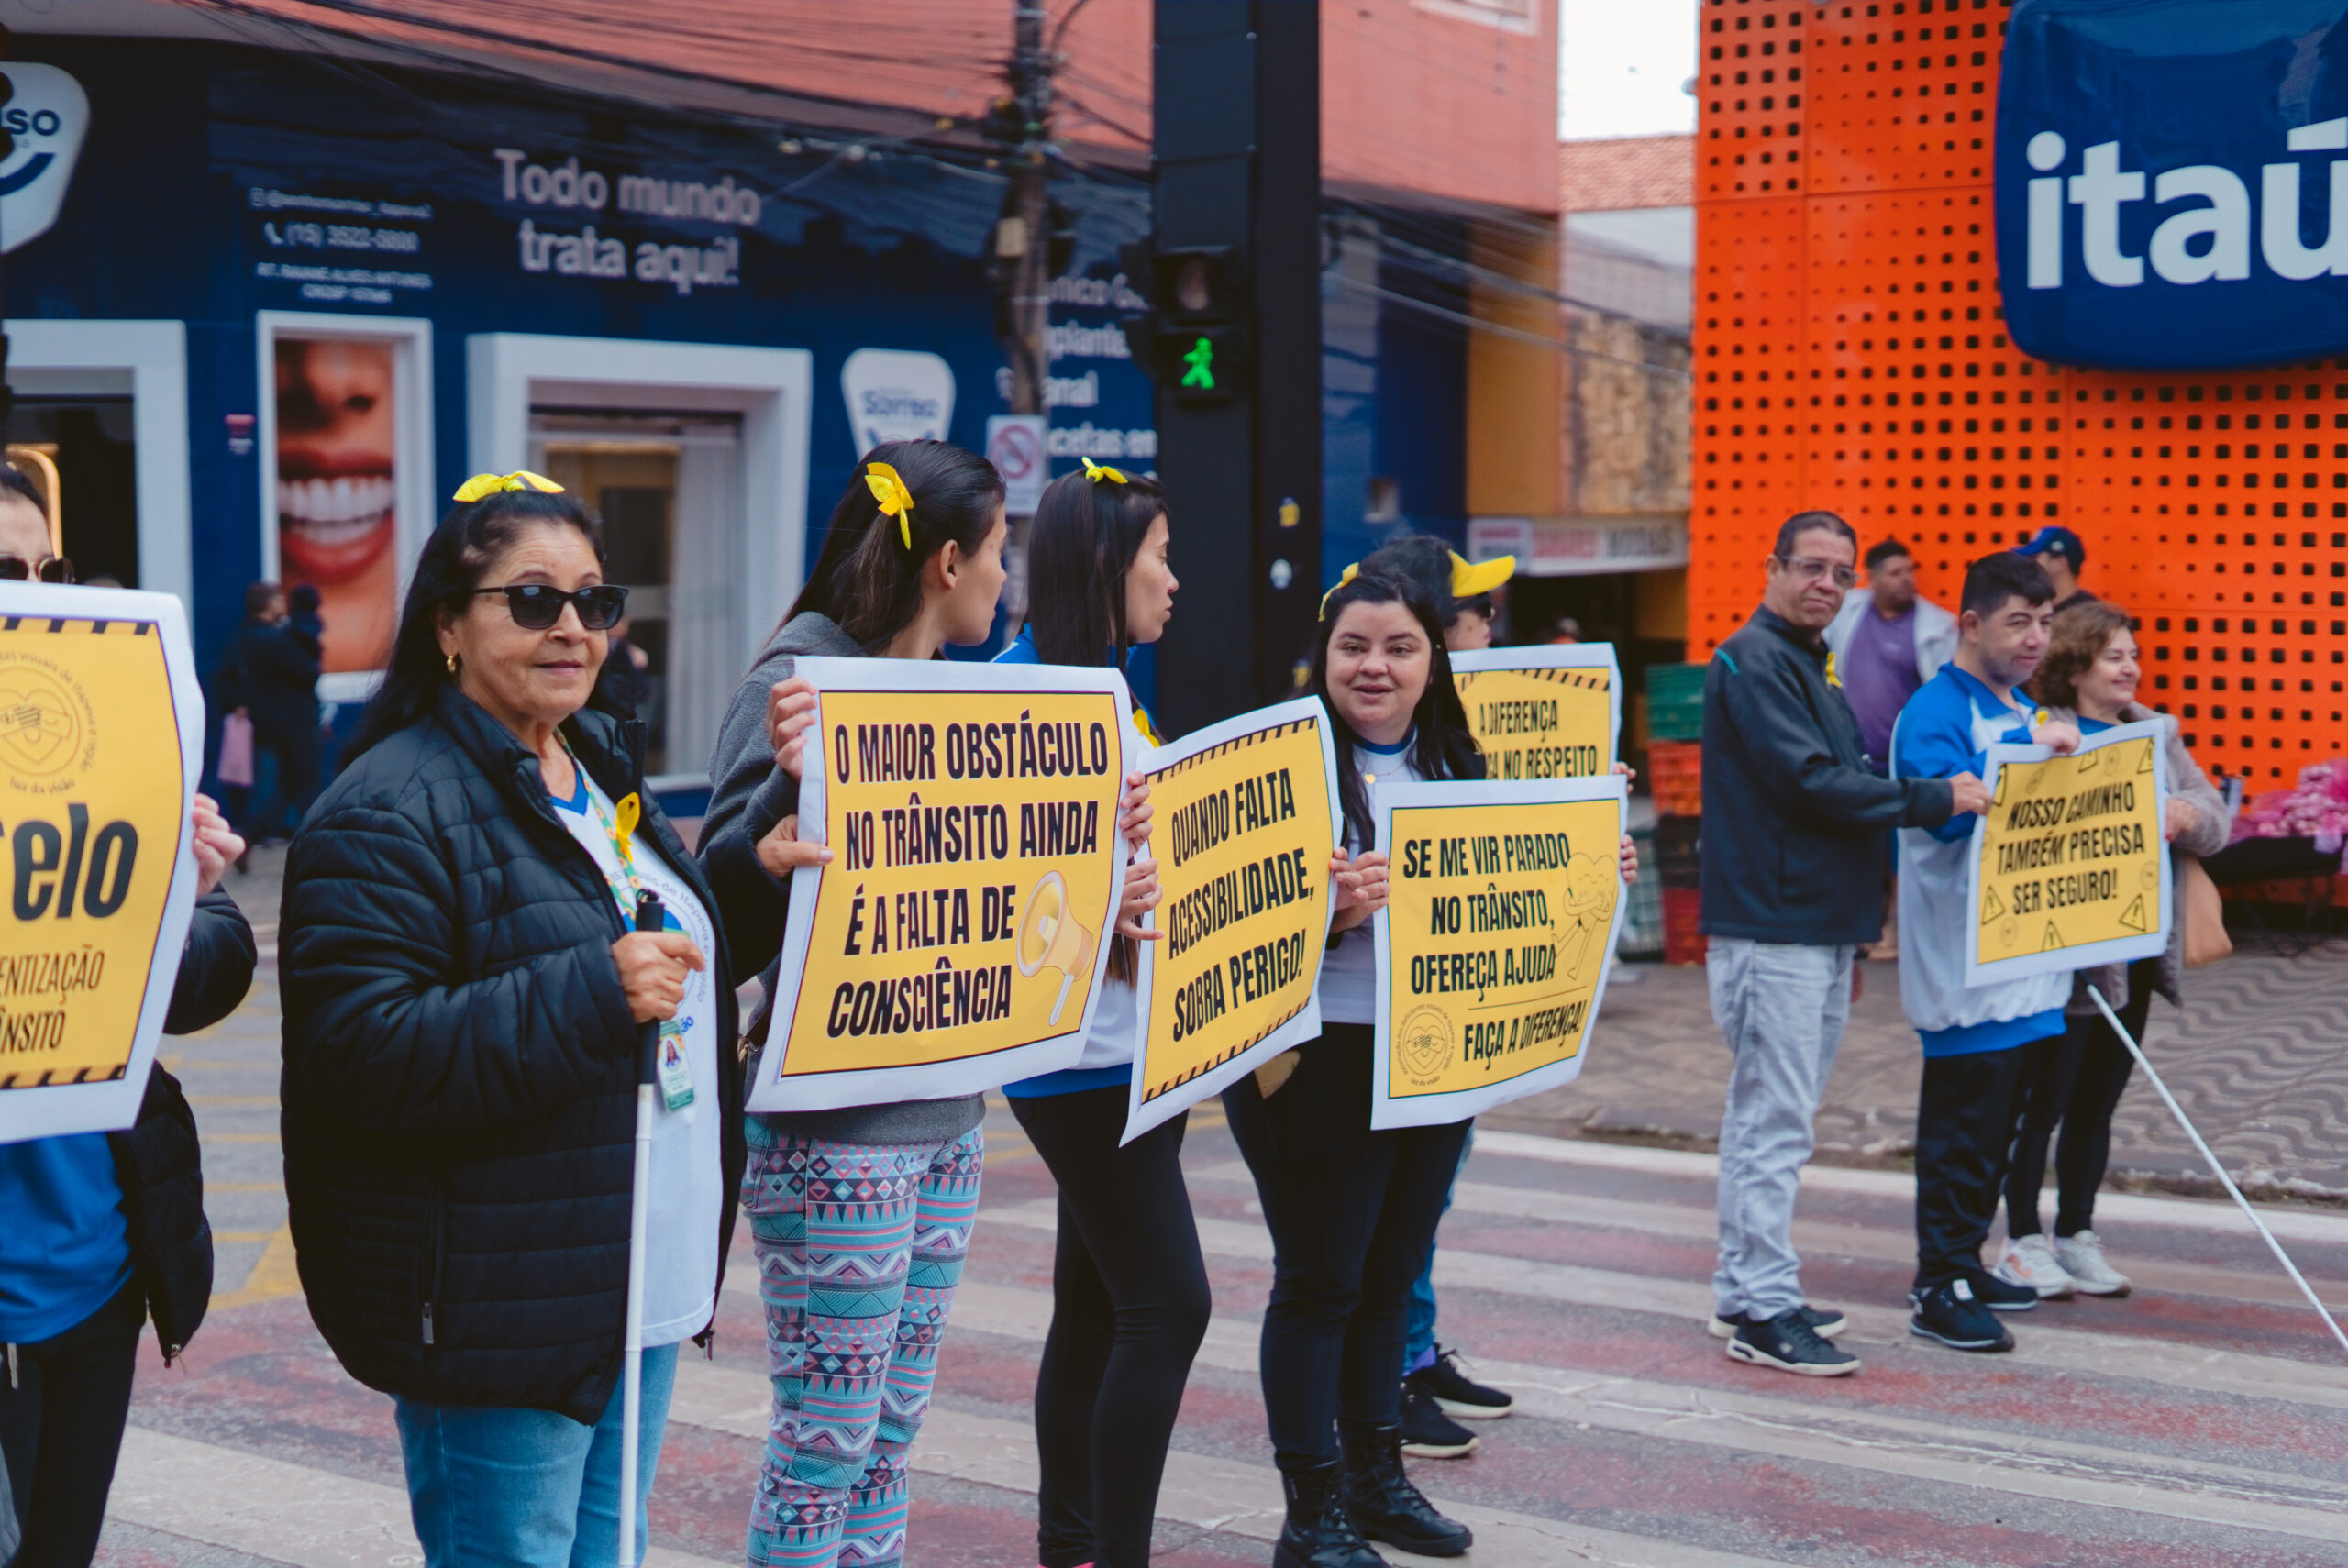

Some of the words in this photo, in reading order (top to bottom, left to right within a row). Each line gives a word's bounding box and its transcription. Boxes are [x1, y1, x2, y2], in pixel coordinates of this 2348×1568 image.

[493, 148, 609, 210] Todo
[616, 175, 761, 226] mundo
[2026, 116, 2348, 289] itaú
[518, 218, 627, 277] trata
[835, 724, 850, 784] O
[858, 723, 936, 783] MAIOR
[946, 709, 1108, 780] OBSTÁCULO
[1503, 749, 1522, 780] NO
[1526, 745, 1598, 780] RESPEITO
[847, 811, 874, 871] NO
[882, 791, 1008, 867] TRÂNSITO
[1019, 801, 1098, 858] AINDA
[1172, 789, 1230, 867] QUANDO
[1235, 767, 1296, 835] FALTA
[2005, 797, 2066, 832] NOSSO
[2066, 780, 2135, 823] CAMINHO
[0, 801, 138, 922] elo
[1403, 839, 1432, 878] SE
[1439, 837, 1468, 878] ME
[1471, 835, 1501, 875] VIR
[1504, 832, 1571, 872] PARADO
[1997, 831, 2066, 876] TAMBÉM
[2070, 823, 2145, 862] PRECISA
[843, 884, 865, 955] É
[871, 896, 888, 955] A
[896, 888, 970, 951] FALTA
[981, 884, 1016, 942] DE
[1169, 845, 1314, 962] ACESSIBILIDADE,
[1431, 895, 1461, 935] NO
[1467, 882, 1555, 933] TRÂNSITO,
[2013, 881, 2042, 916] SER
[2047, 868, 2118, 910] SEGURO!
[826, 956, 1013, 1038] CONSCIÊNCIA
[1173, 963, 1226, 1043] SOBRA
[1229, 928, 1307, 1010] PERIGO!
[1411, 950, 1498, 1002] OFEREÇA
[1502, 944, 1556, 987] AJUDA
[1464, 1020, 1505, 1071] FAÇA
[1507, 1018, 1522, 1053] A
[1519, 999, 1589, 1051] DIFERENÇA!
